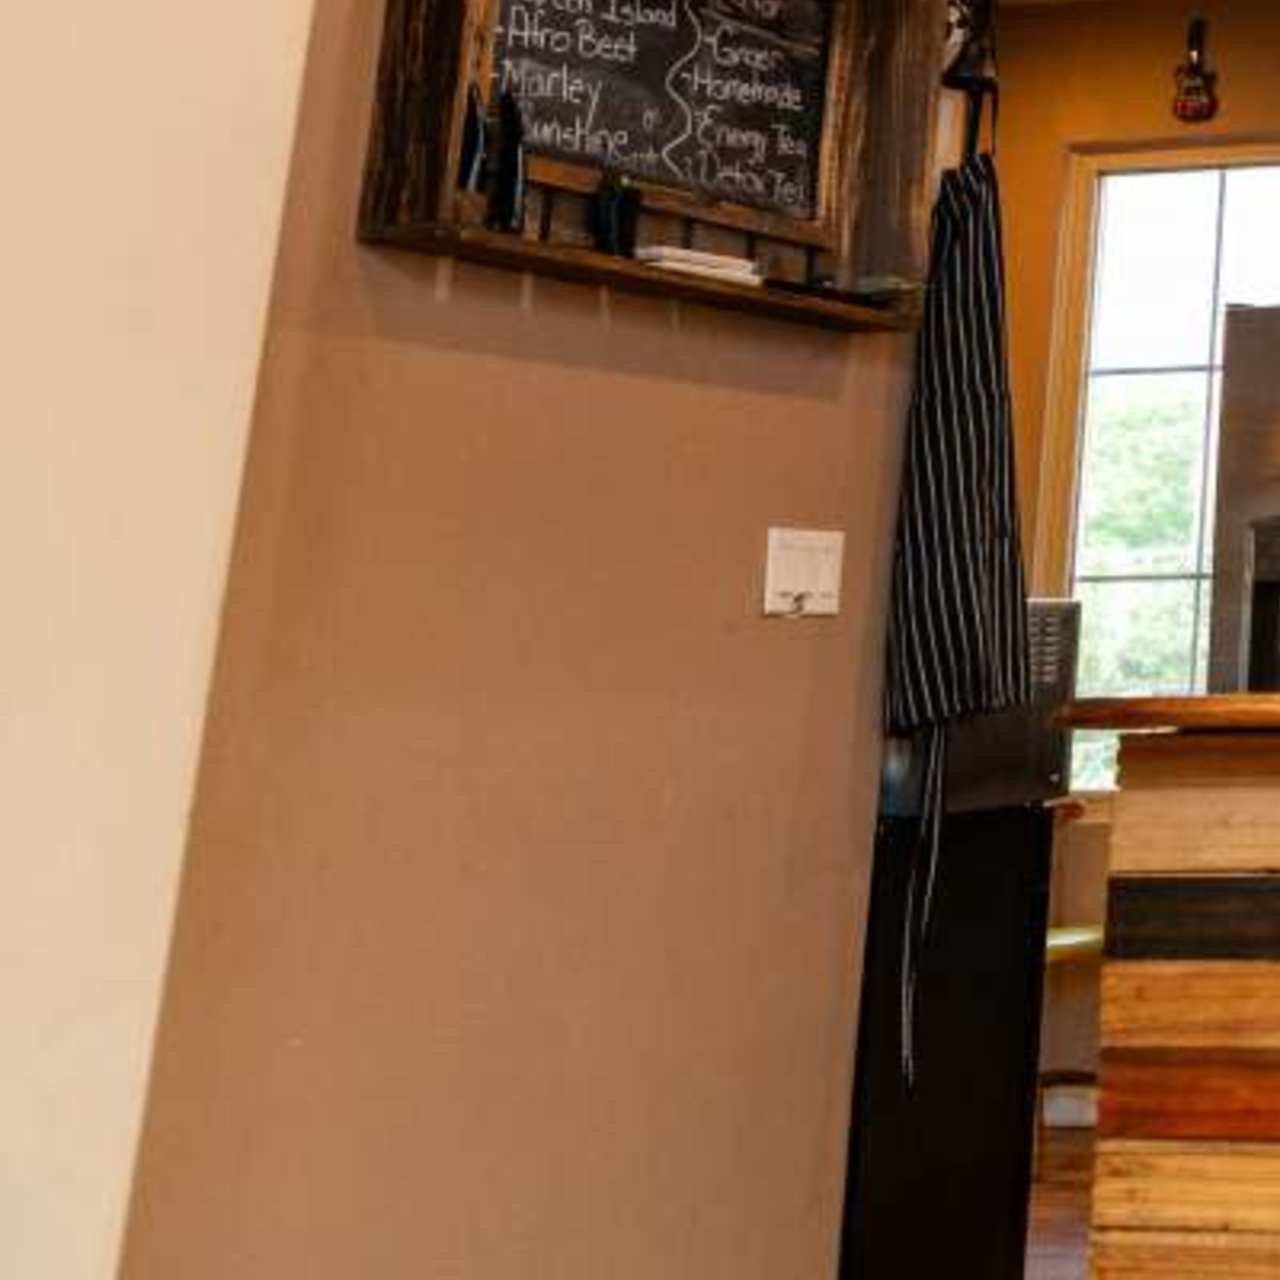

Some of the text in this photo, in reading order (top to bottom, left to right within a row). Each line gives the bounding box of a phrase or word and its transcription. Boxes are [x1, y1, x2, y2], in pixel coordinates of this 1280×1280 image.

[507, 5, 637, 63] Afro Beet
[501, 60, 603, 136] Marley
